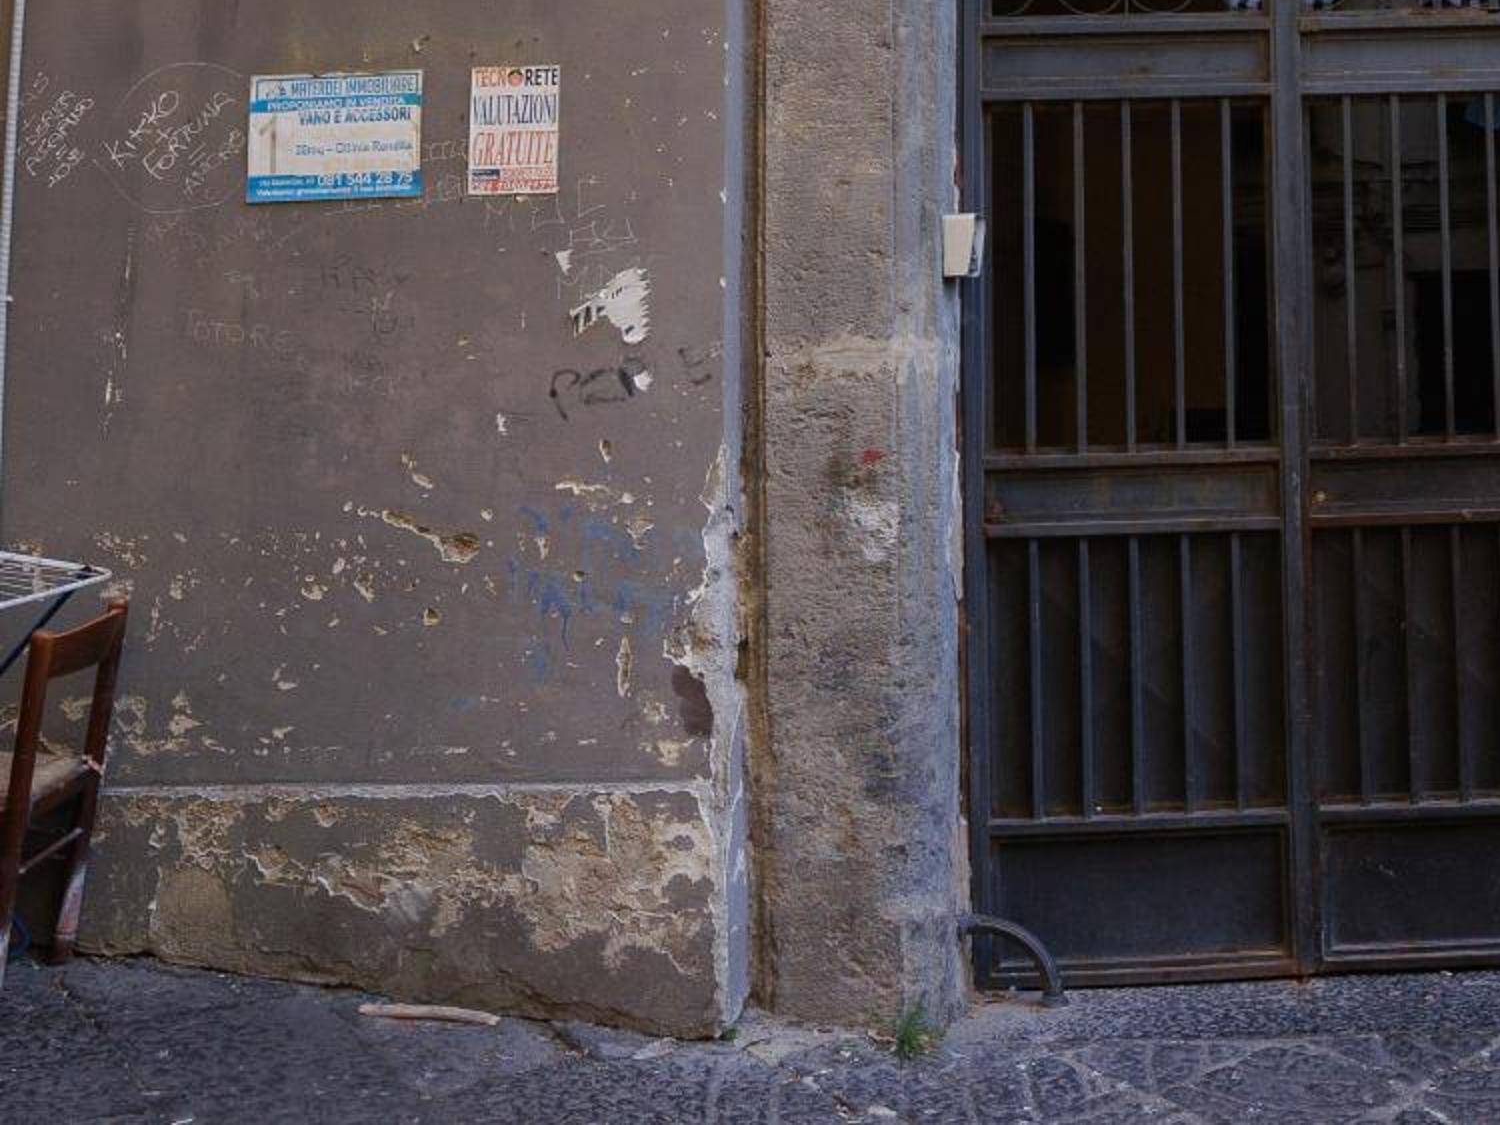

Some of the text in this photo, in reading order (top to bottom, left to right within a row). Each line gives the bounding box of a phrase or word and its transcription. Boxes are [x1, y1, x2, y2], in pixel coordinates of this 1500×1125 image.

[291, 76, 415, 97] MATERDEI IMMOBILIARE
[267, 99, 342, 113] PROPONIAMO
[473, 94, 557, 126] VALUTAZIONI
[298, 107, 411, 125] VANO E ACCESSORI
[473, 129, 559, 167] GRATUITE
[318, 172, 342, 187] 081
[346, 171, 371, 186] 544
[376, 170, 393, 185] 28
